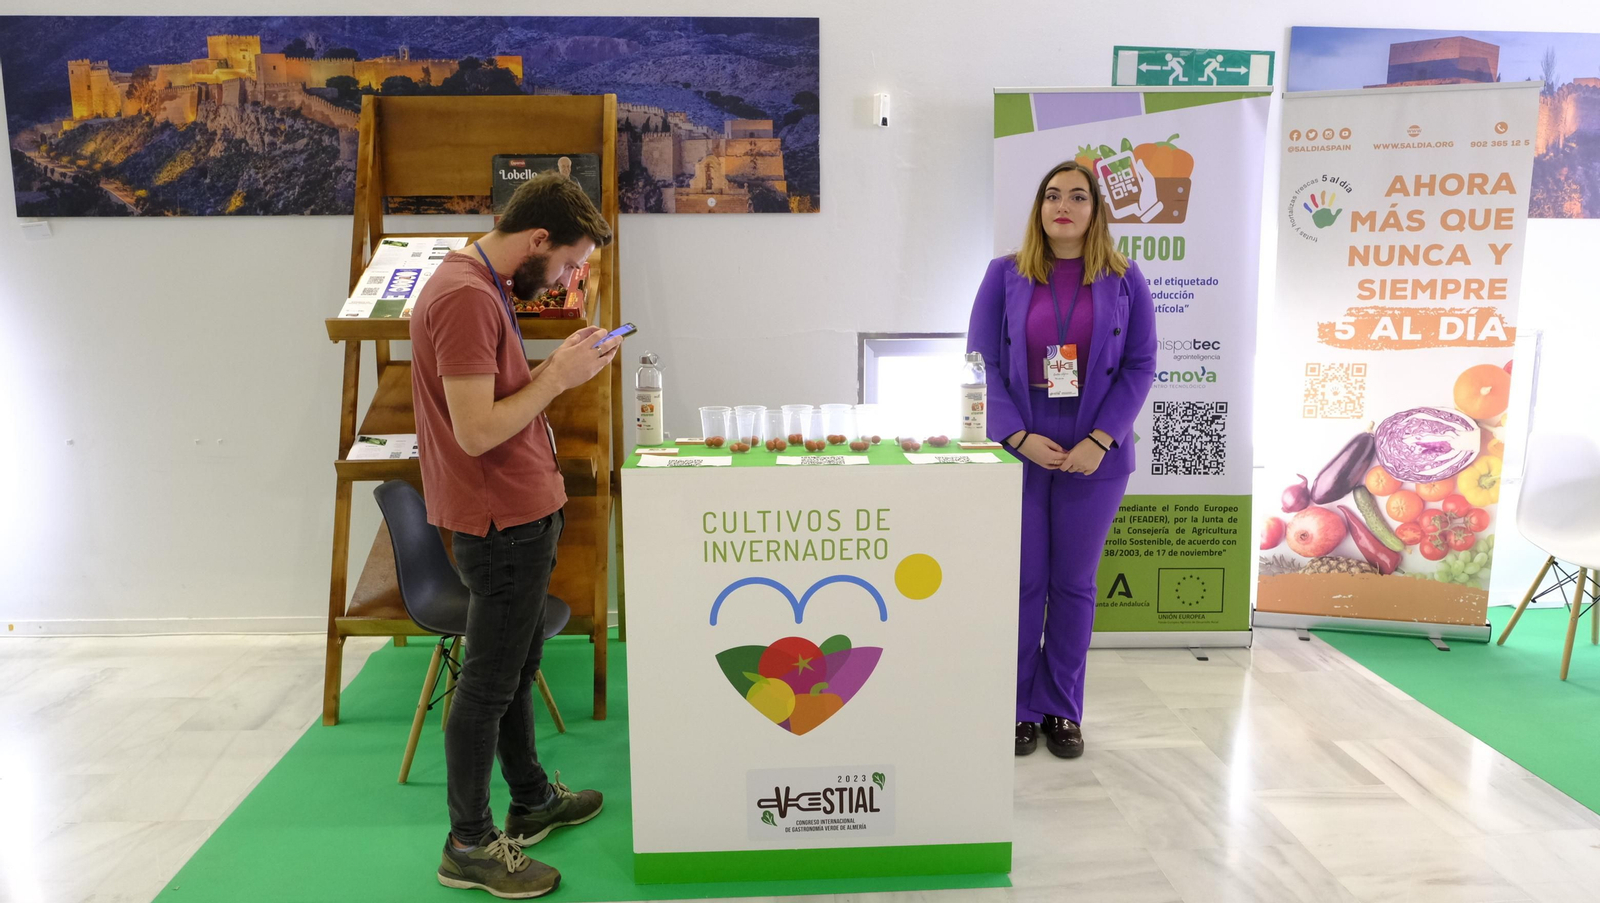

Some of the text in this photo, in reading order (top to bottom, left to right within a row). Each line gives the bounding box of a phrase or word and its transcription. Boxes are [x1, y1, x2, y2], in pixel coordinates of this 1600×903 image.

[1287, 144, 1352, 153] @5ALDIASPAIN
[1373, 141, 1454, 150] WWW.5ALDIA.ORG
[1470, 140, 1488, 148] 902
[1511, 139, 1521, 147] 12
[498, 168, 538, 180] Lobello
[1321, 174, 1353, 194] 5 al día
[1384, 172, 1517, 198] AHORA
[1287, 195, 1298, 228] hortalizas
[1350, 203, 1515, 233] MÁS QUE
[1299, 230, 1318, 243] frutas
[1117, 235, 1186, 261] 4FOOD
[1348, 243, 1513, 267] NUNCA Y
[1153, 276, 1162, 286] el
[1164, 276, 1219, 288] etiquetado
[1151, 290, 1195, 300] oducción
[1356, 278, 1508, 301] SIEMPRE
[1334, 308, 1508, 341] 5 AL DÍA
[1173, 354, 1221, 362] agrointeligencia
[1118, 504, 1239, 514] mediante el Fondo Europeo
[702, 508, 891, 534] CULTIVOS DE
[1129, 515, 1170, 524] (FEADER),
[1174, 517, 1187, 525] por
[1191, 515, 1198, 523] la
[1201, 515, 1224, 524] Junta
[1227, 515, 1238, 523] de
[1113, 526, 1238, 536] la Consejería de Agricultura
[1129, 537, 1174, 546] Sostenible,
[1175, 537, 1186, 545] de
[1187, 537, 1220, 546] acuerdo
[703, 537, 889, 563] INVERNADERO
[1104, 548, 1227, 558] 38/2003, de 17 de noviembre"
[1157, 612, 1178, 620] UNIÓN
[837, 774, 867, 783] 2023
